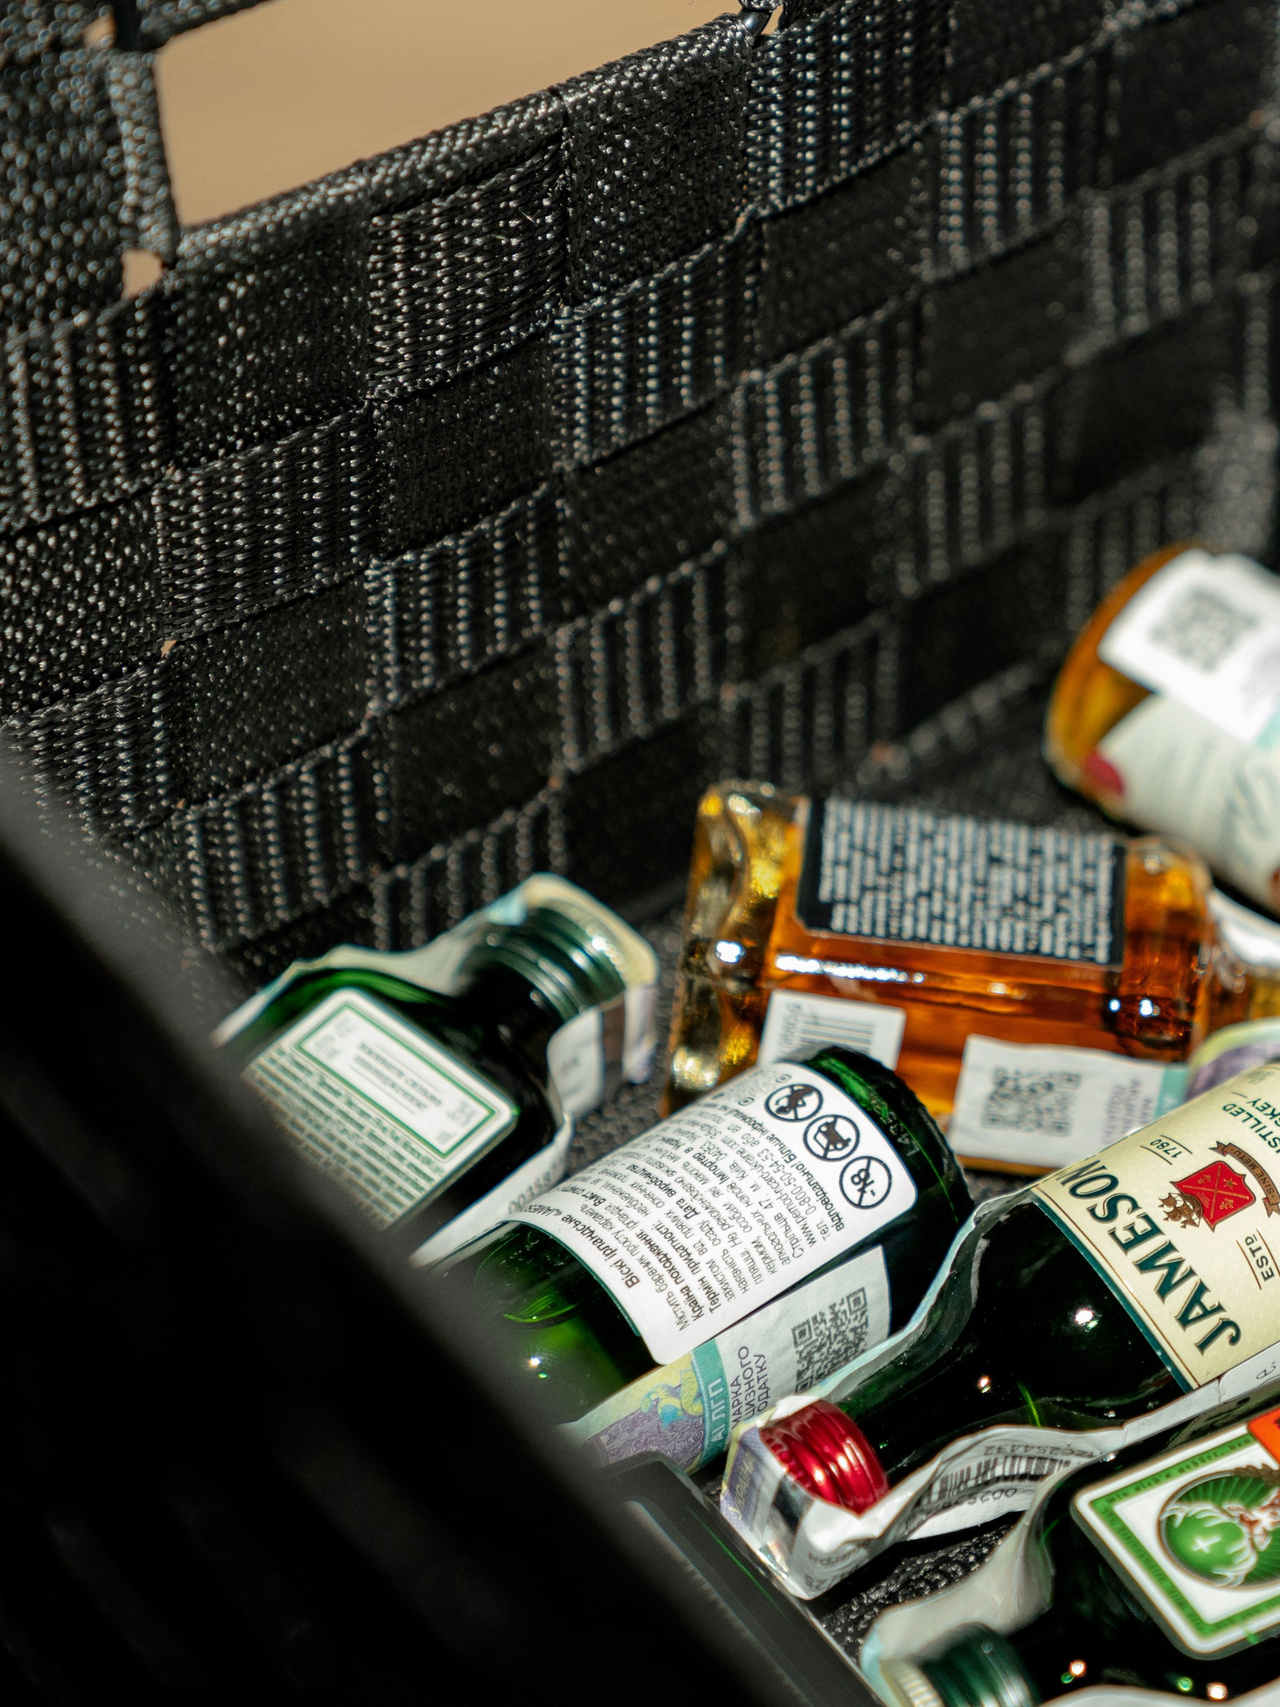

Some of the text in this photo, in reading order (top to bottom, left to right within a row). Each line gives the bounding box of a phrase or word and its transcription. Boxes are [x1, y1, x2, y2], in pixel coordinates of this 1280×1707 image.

[738, 1130, 760, 1148] або
[764, 1131, 797, 1165] Більше
[1147, 1134, 1184, 1161] 1780
[625, 1161, 677, 1198] виробництва
[691, 1149, 730, 1186] Імпортер
[755, 1145, 818, 1216] 0-800-50-54-53
[675, 1196, 699, 1222] Дата
[789, 1158, 846, 1233] відповідально!
[559, 1211, 619, 1263] ірландське
[610, 1226, 642, 1257] просту
[663, 1207, 695, 1240] прямих
[726, 1230, 742, 1250] Не
[748, 1207, 792, 1268] алкогольних
[771, 1210, 805, 1260] Стрільців
[814, 1217, 832, 1240] тел.
[633, 1226, 686, 1286] походження:
[649, 1218, 722, 1314] Термін придатності:
[691, 1238, 708, 1257] від
[749, 1234, 778, 1276] кермом,
[1054, 1146, 1248, 1366] JAMESON
[608, 1256, 640, 1290] Віскі
[635, 1253, 669, 1295] барвник
[704, 1257, 736, 1303] захистом
[717, 1247, 750, 1294] наявність
[662, 1289, 690, 1332] Містить
[678, 1283, 705, 1322] Країна
[736, 1346, 754, 1417] ЦИЗНОГО
[750, 1353, 764, 1411] ОДАТКУ
